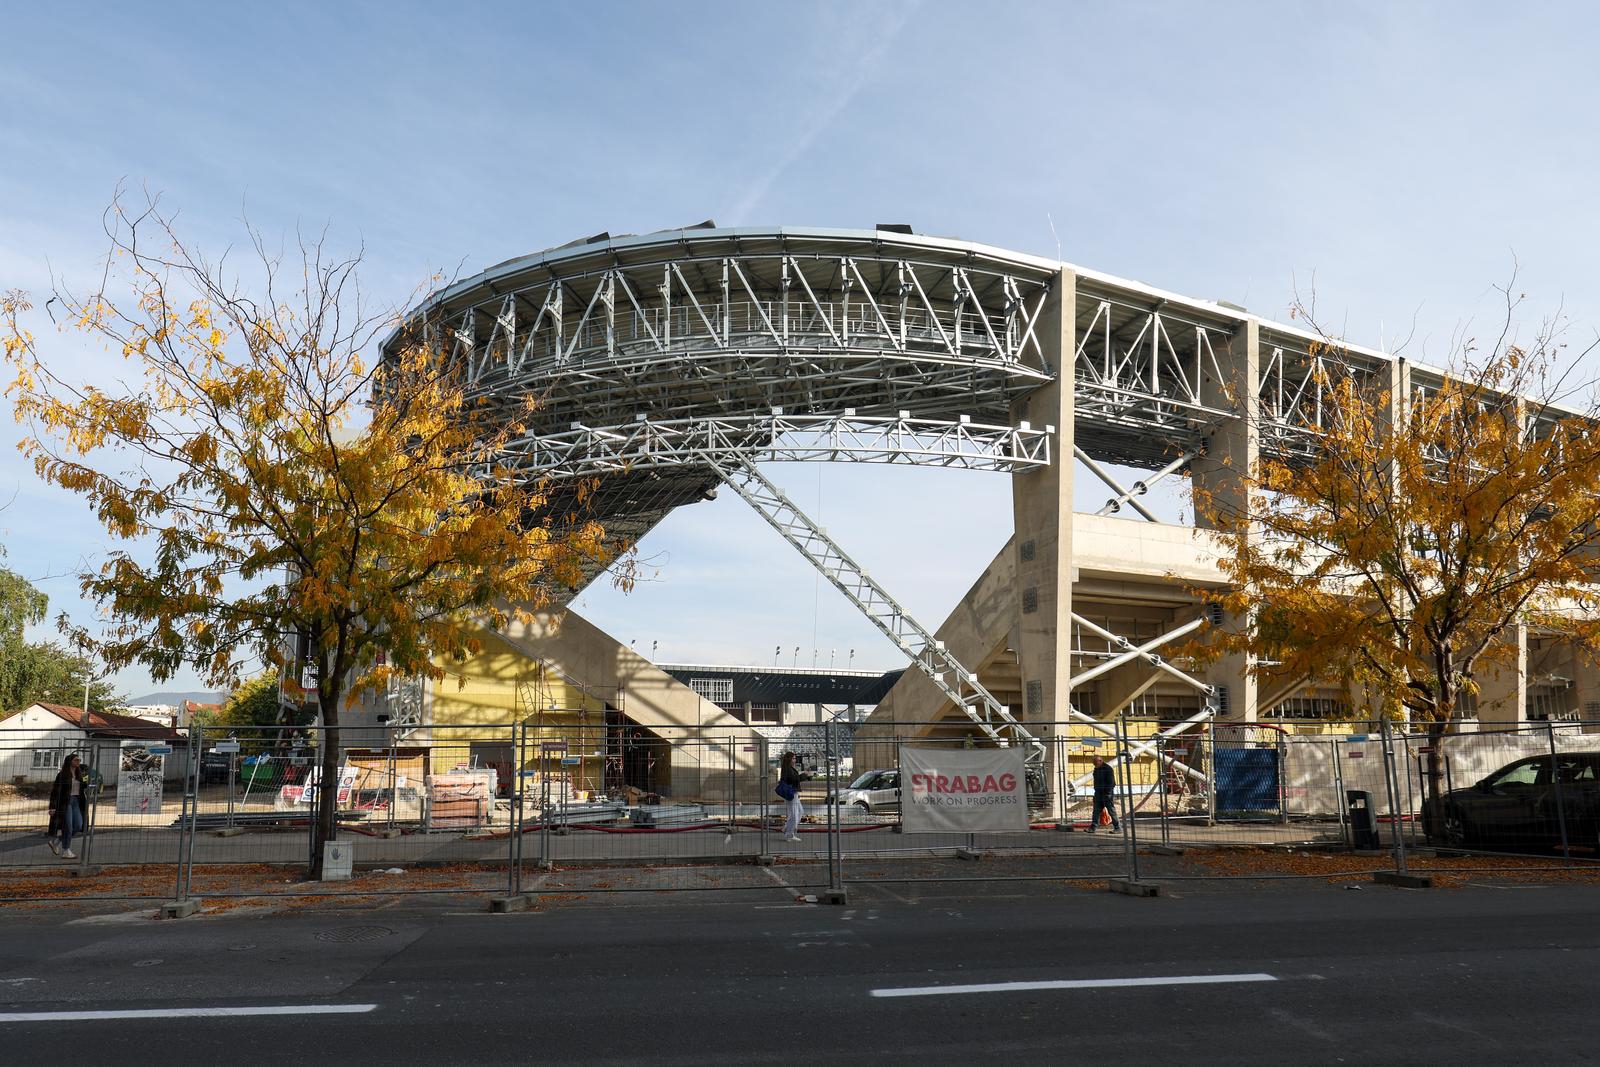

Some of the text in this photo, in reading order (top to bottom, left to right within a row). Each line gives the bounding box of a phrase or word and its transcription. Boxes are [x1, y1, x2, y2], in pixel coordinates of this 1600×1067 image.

[911, 773, 1017, 794] STRABAG
[912, 796, 1017, 806] WORK ON PROGRESS
